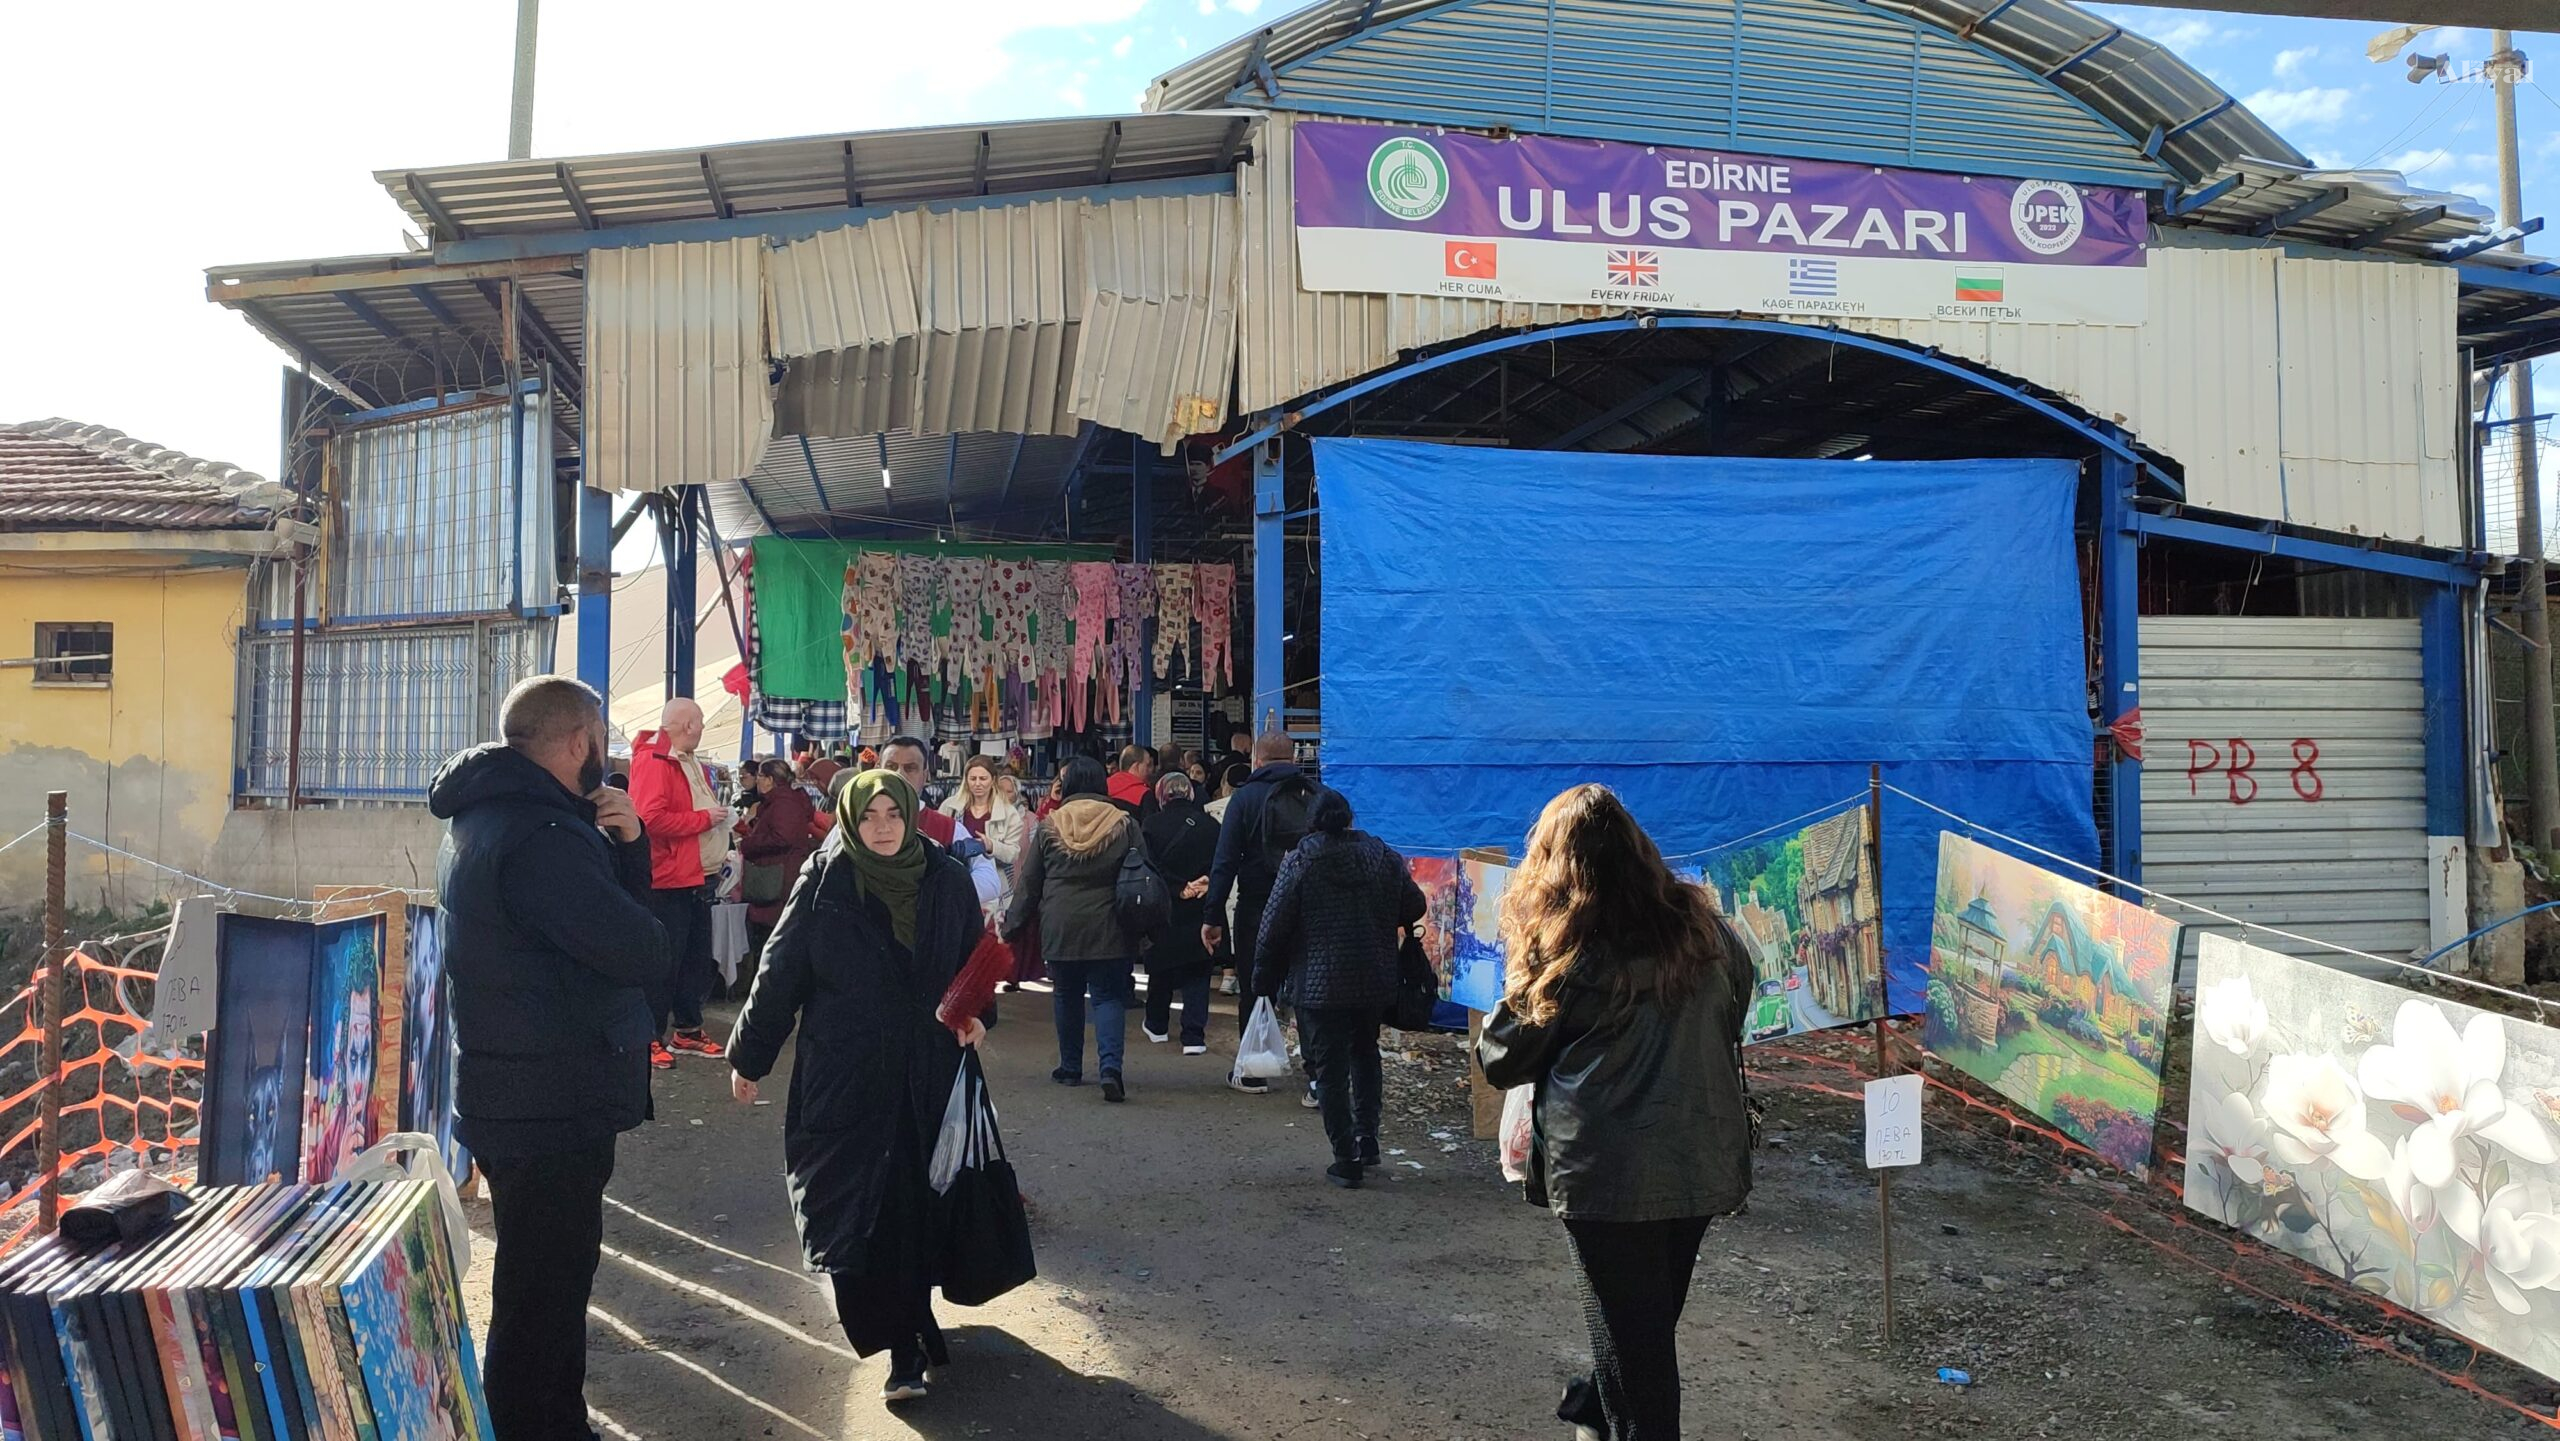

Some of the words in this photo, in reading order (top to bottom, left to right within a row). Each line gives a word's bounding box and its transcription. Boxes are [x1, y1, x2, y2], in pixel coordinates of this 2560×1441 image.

[1400, 141, 1415, 149] T.C.
[1666, 156, 1791, 194] EDİRNE
[1498, 185, 1691, 239] ULUS
[1718, 199, 1968, 254] PAZARI
[2018, 203, 2077, 225] UPEK
[1438, 281, 1465, 294] HER
[1467, 283, 1503, 296] CUMA
[1590, 289, 1630, 301] EVERY
[1632, 291, 1676, 304] FRIDAY
[1936, 305, 1978, 317] ВСЕКИ
[1980, 306, 2023, 319] ПЕТЪК
[2187, 737, 2258, 805] PB
[2290, 737, 2324, 802] 8
[1879, 1086, 1900, 1118] 10
